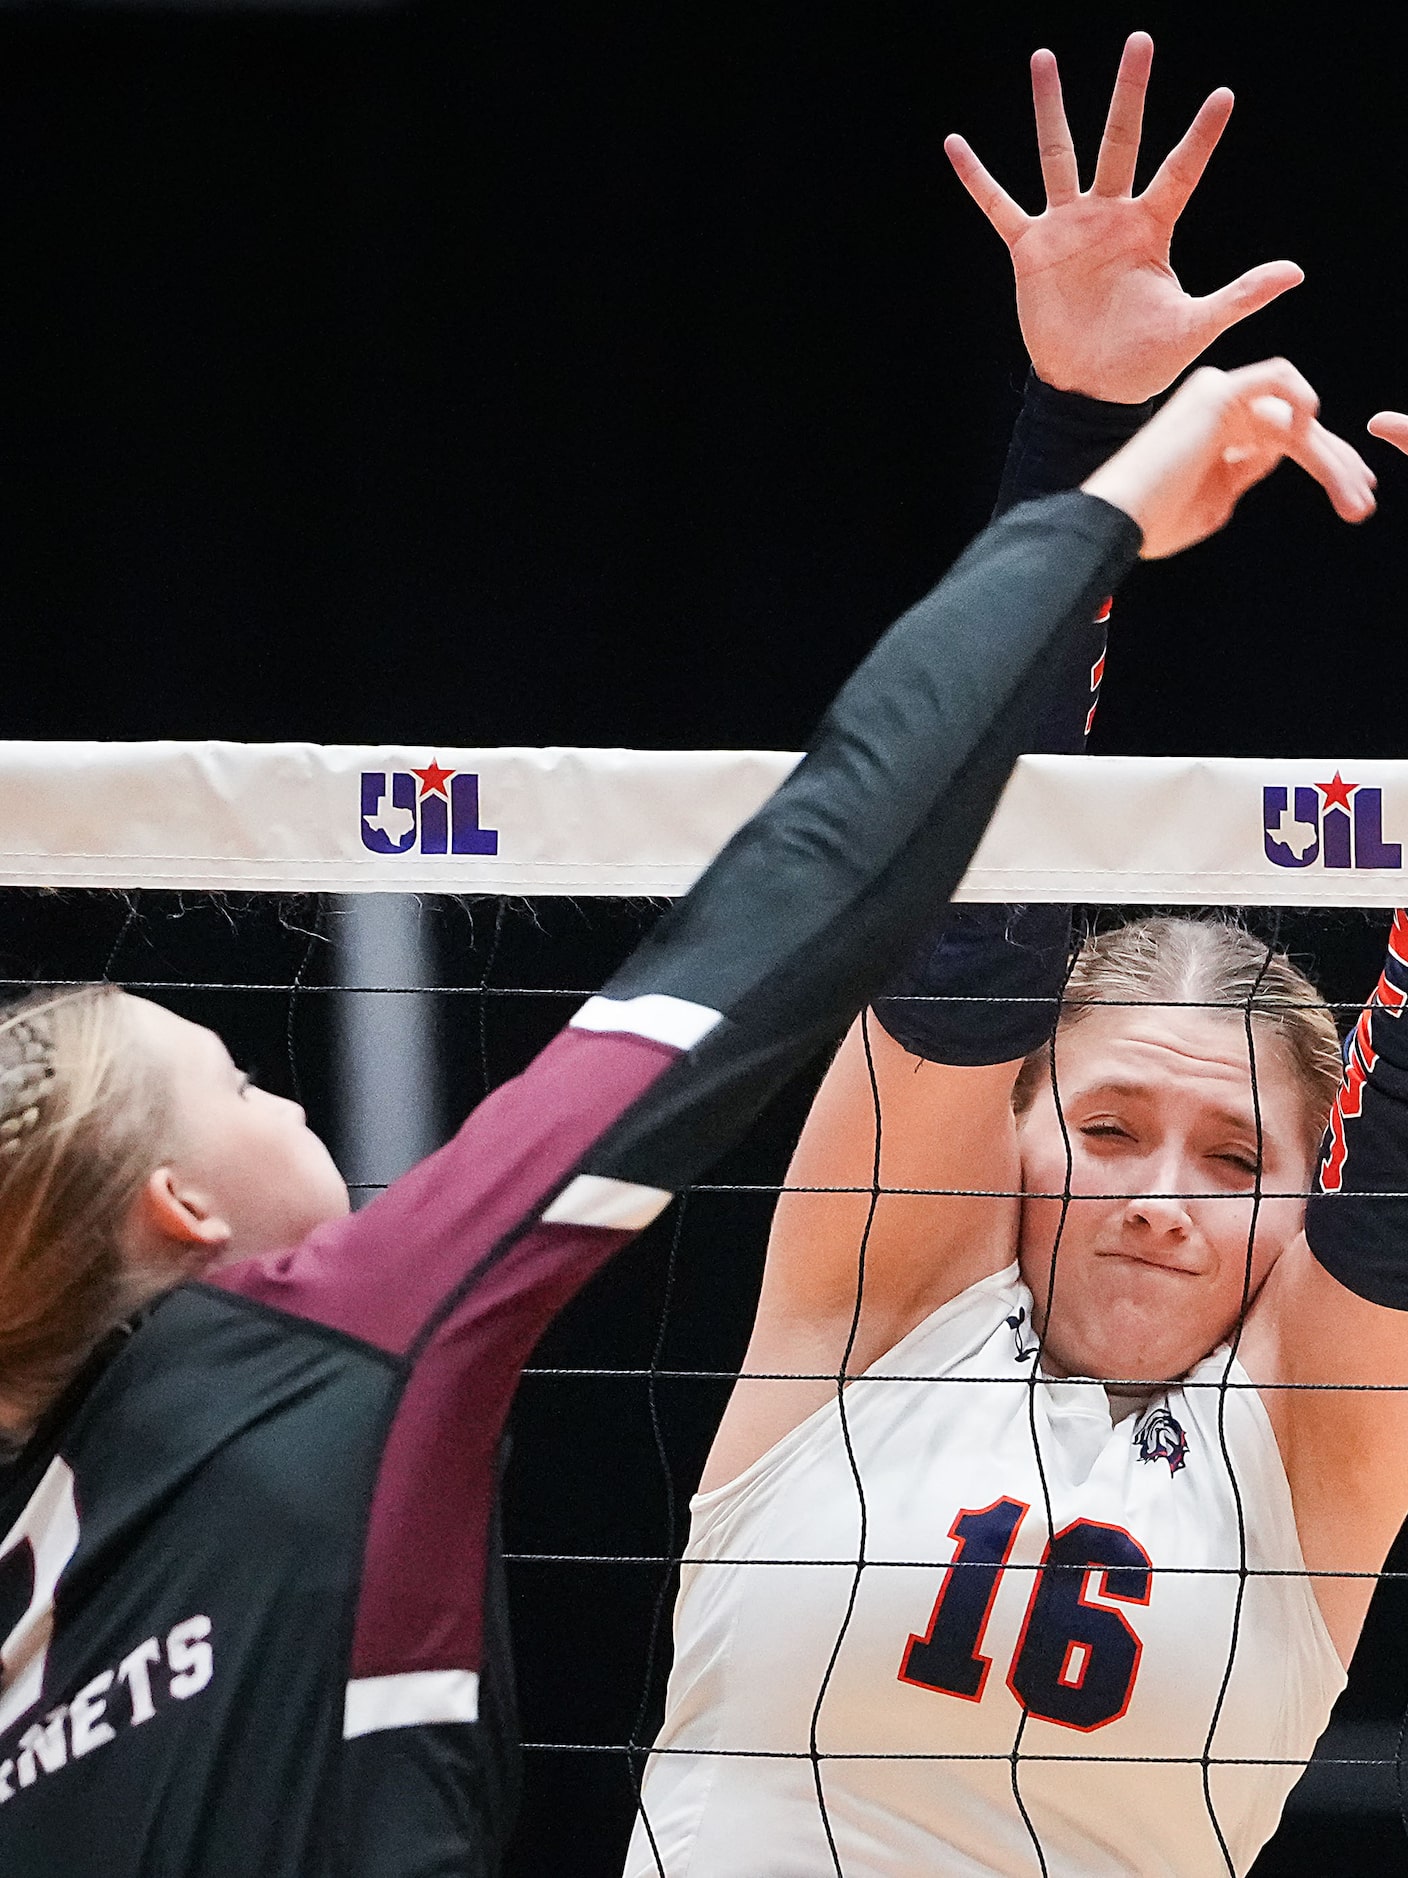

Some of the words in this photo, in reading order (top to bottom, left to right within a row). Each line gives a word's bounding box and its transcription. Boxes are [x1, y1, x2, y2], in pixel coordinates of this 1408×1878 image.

[361, 757, 498, 855] UIL
[1263, 770, 1402, 869] UIL
[897, 1495, 1153, 1733] 16
